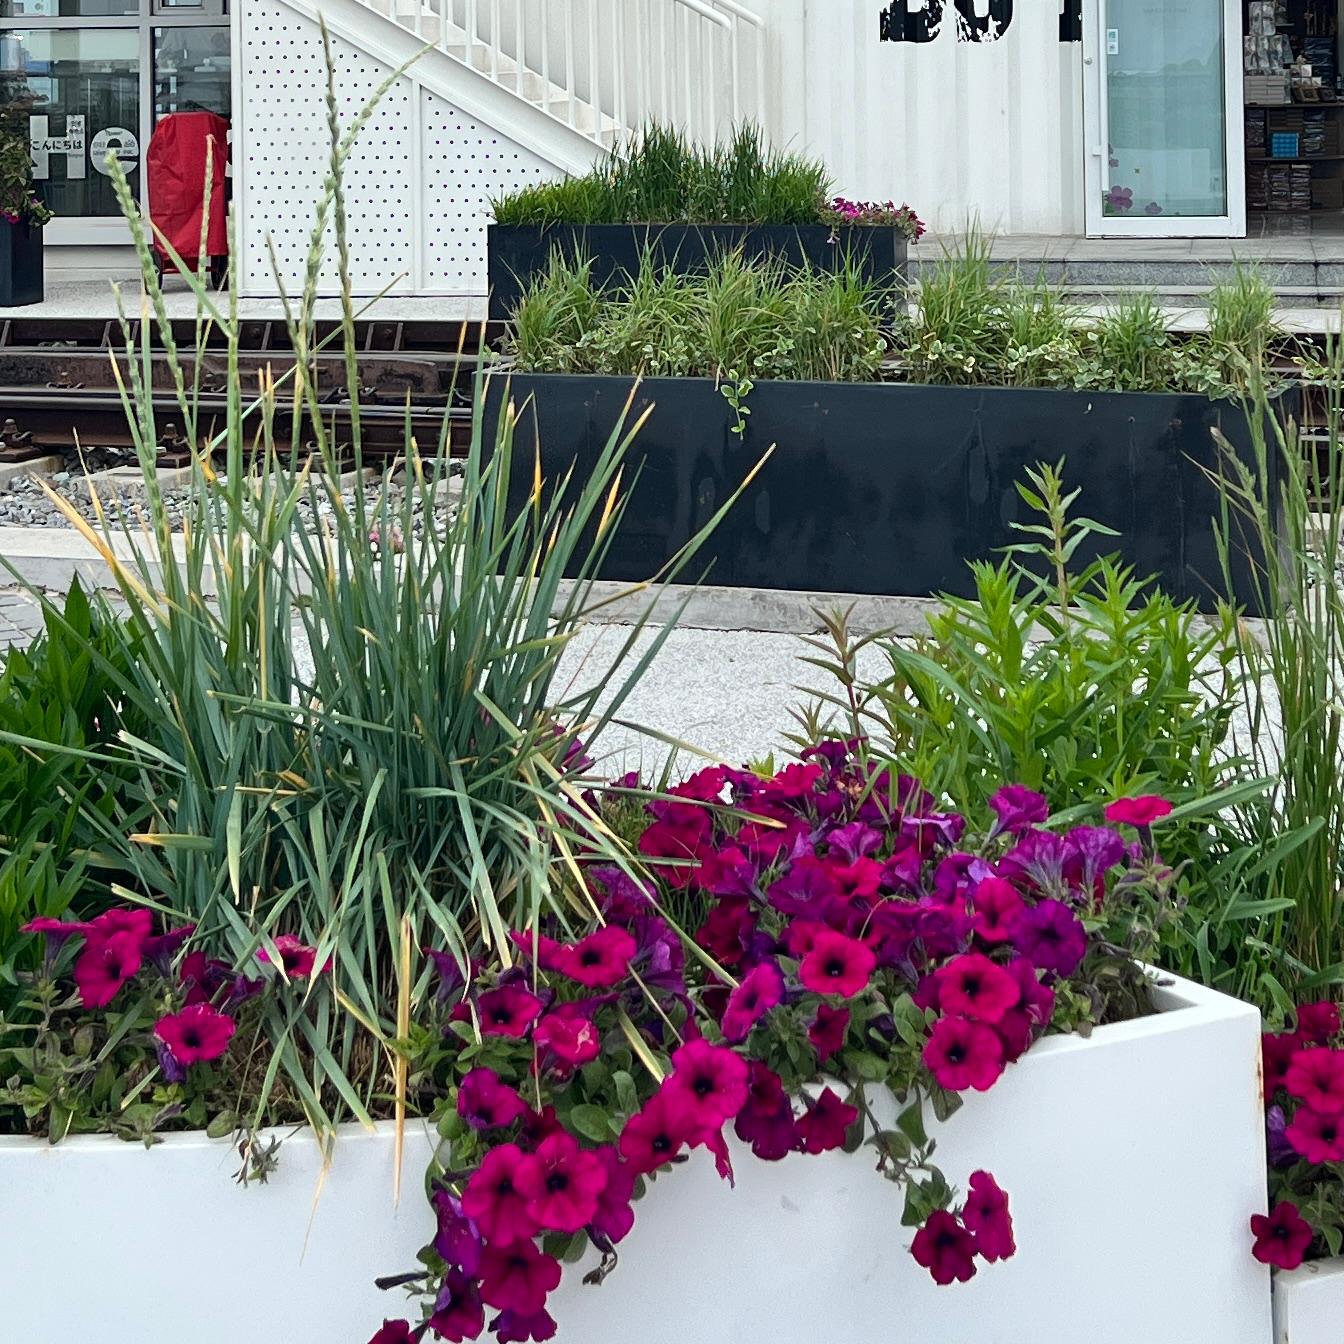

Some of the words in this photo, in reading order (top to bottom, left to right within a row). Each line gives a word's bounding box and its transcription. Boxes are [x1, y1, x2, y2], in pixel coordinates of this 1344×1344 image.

[31, 139, 84, 151] こんにちは
